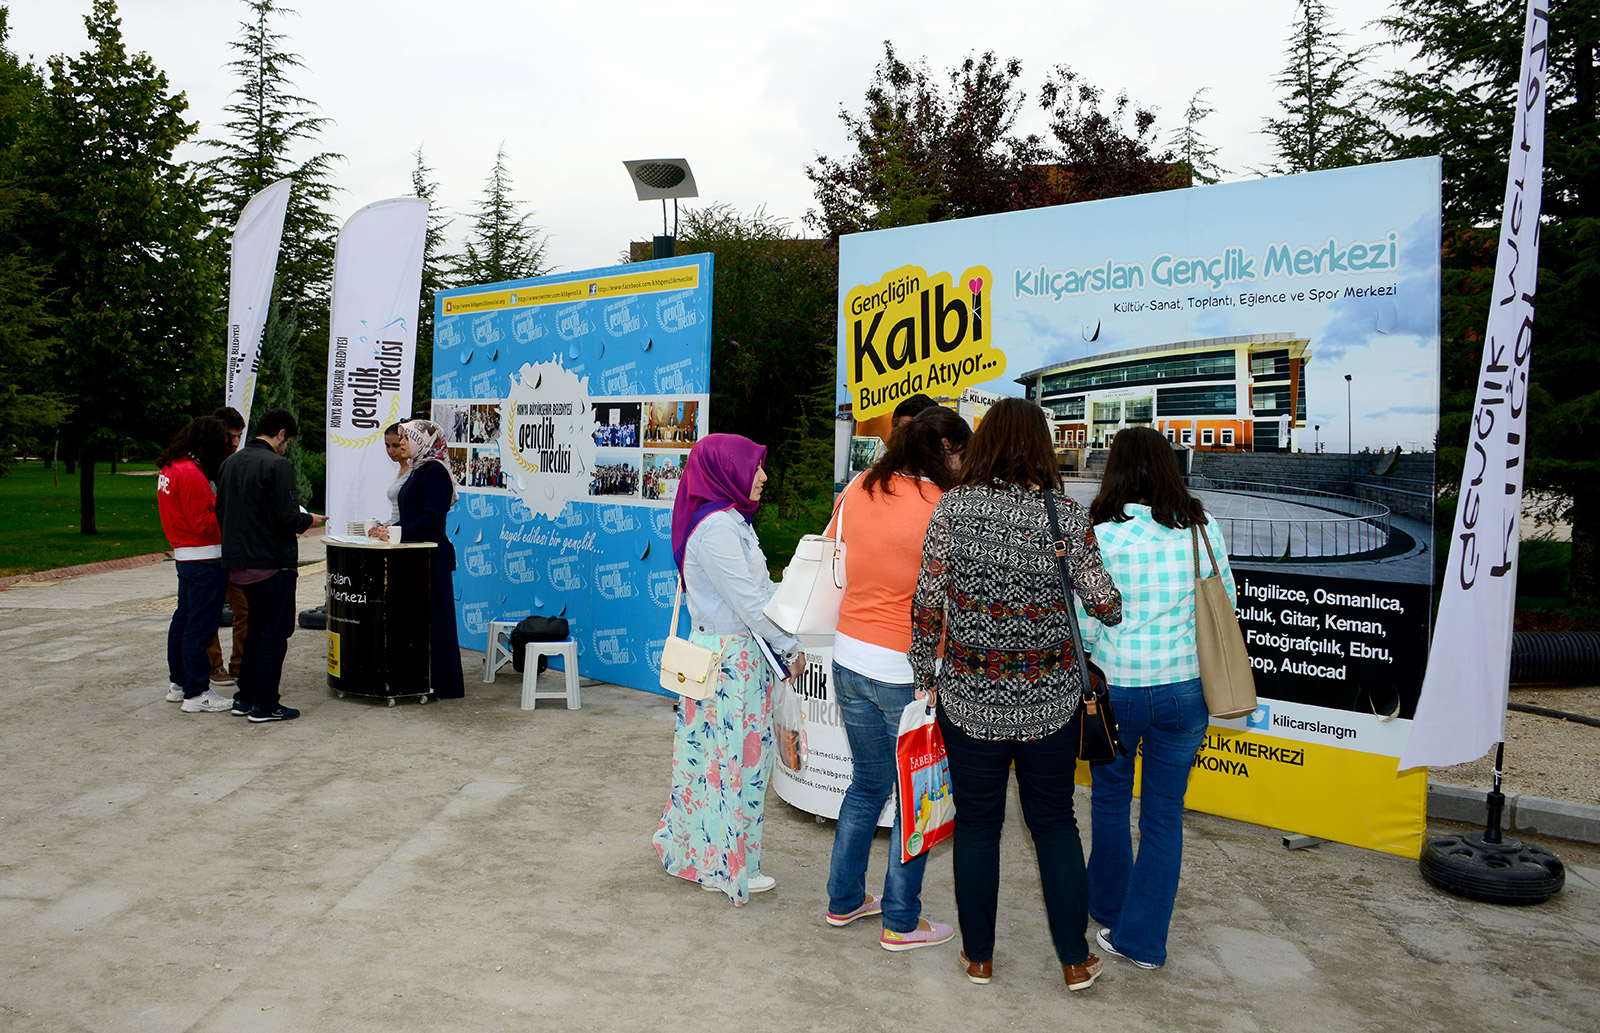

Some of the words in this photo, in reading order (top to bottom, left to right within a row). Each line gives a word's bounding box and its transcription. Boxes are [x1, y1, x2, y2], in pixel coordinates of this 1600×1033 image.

[1015, 260, 1144, 301] Kılıçarslan
[1151, 248, 1256, 289] Gençlik
[1264, 233, 1397, 277] Merkezi
[852, 275, 920, 316] Gençliğin
[1113, 299, 1184, 313] Kültür-Sanat,
[1187, 295, 1236, 310] Toplantı,
[1239, 291, 1287, 308] Eğlence
[1290, 291, 1305, 302] ve
[1309, 288, 1340, 303] Spor
[1343, 283, 1397, 299] Merkezi
[854, 279, 983, 384] Kalbi
[374, 340, 404, 392] meclisi
[860, 371, 923, 411] Burada
[926, 353, 998, 388] Atıyor...
[347, 367, 382, 429] gençlik
[518, 416, 555, 454] gençlik
[540, 443, 572, 474] meclisi
[499, 523, 522, 549] hayal
[522, 526, 548, 546] edilesi
[548, 528, 561, 547] bir
[1244, 578, 1310, 606] İngilizce,
[1313, 588, 1405, 615] Osmanlıca,
[1280, 609, 1321, 631] Gitar,
[1325, 614, 1387, 638] Keman,
[1246, 629, 1345, 658] Fotoğrafçılık,
[1350, 641, 1394, 664] Ebru,
[1280, 657, 1347, 681] Autocad
[1272, 713, 1358, 740] kilicarslangm
[1234, 739, 1305, 767] MERKEZİ
